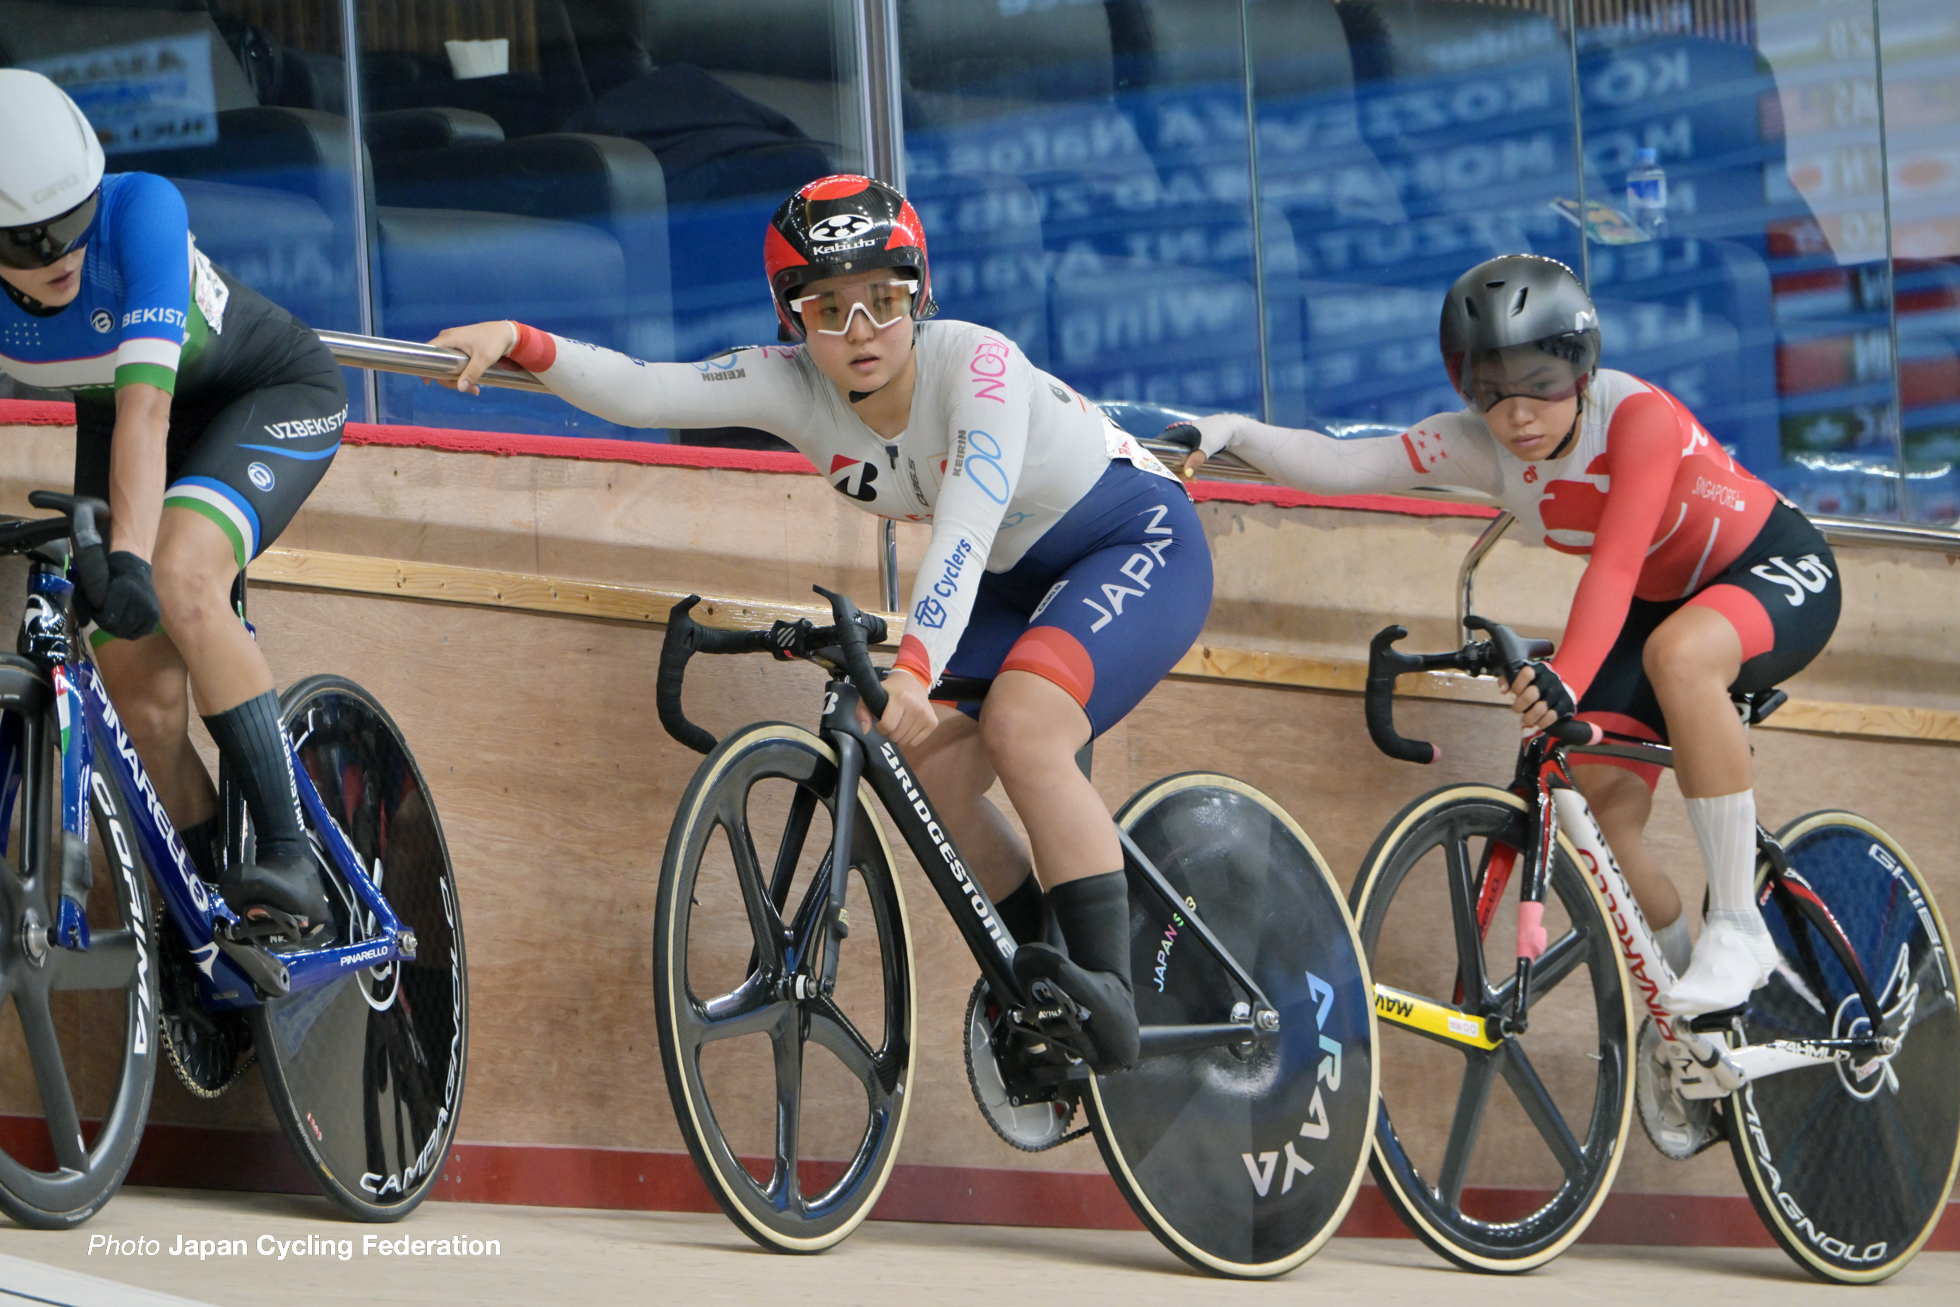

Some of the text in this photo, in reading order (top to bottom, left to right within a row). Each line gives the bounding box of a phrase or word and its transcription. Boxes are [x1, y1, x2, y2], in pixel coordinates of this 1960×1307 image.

[813, 239, 876, 256] Kabuto
[701, 368, 746, 382] KEIRIN
[263, 403, 348, 440] UZBEKISTA
[952, 430, 967, 477] KEIRIN
[934, 538, 972, 598] Cyclers
[1082, 504, 1173, 633] JAPAN
[90, 667, 209, 912] PINARELLO
[880, 742, 1016, 959] BRIDGESTONE
[91, 771, 151, 1055] CORIMA
[340, 946, 389, 967] PINARELLO
[1153, 924, 1178, 993] JAPAN
[1242, 971, 1343, 1197] ARAYA
